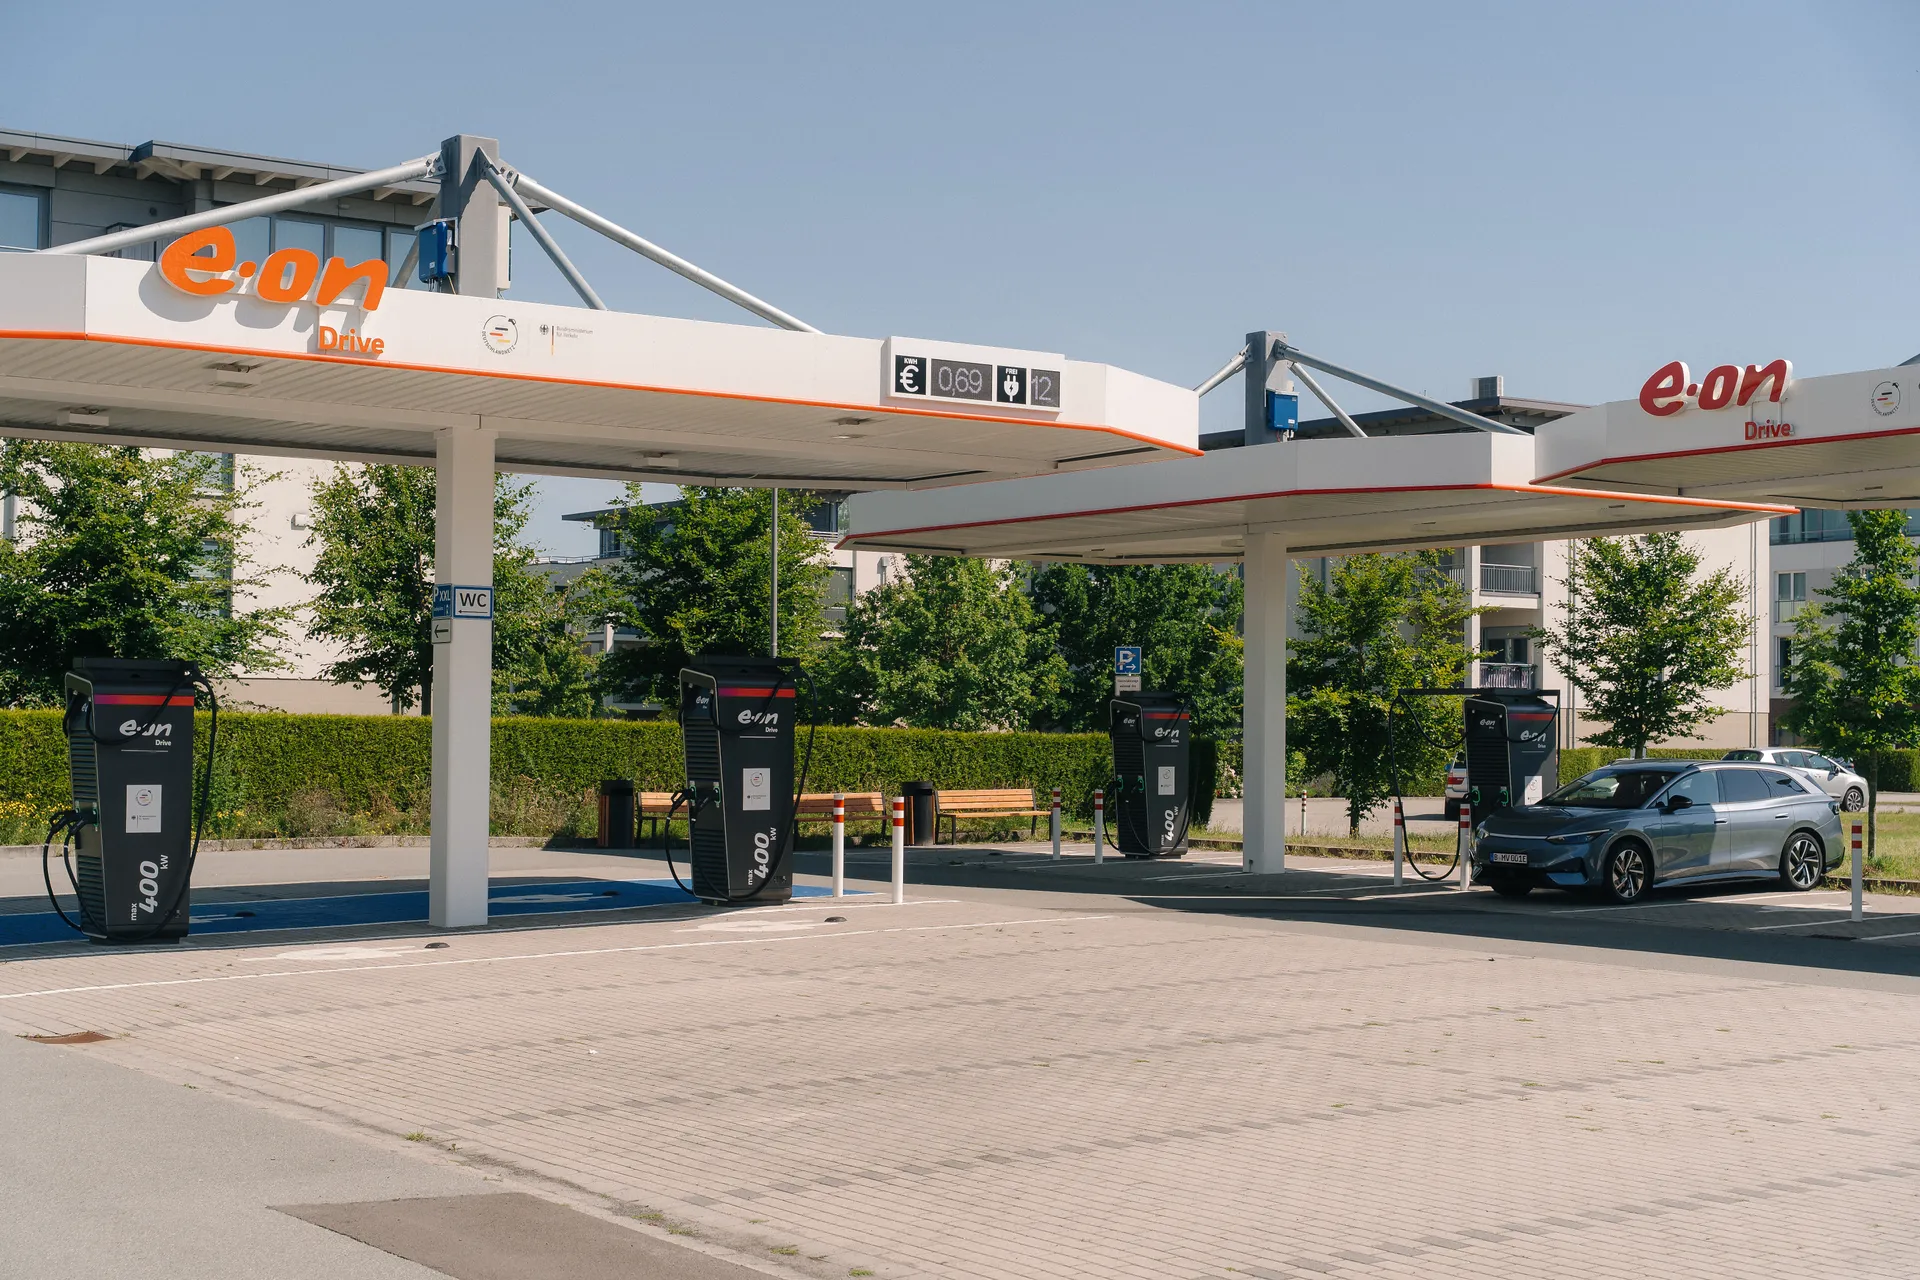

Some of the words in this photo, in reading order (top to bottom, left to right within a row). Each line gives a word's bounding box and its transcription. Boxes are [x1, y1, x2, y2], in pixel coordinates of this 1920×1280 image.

[318, 326, 385, 354] Drive
[904, 357, 918, 365] KWH
[900, 365, 919, 392] €
[938, 366, 983, 396] 0,69
[1031, 375, 1052, 401] 12
[1745, 419, 1791, 440] Drive
[439, 590, 451, 602] XXL
[459, 592, 487, 607] WC
[770, 827, 776, 840] kW
[1164, 809, 1174, 841] 400
[160, 854, 168, 870] kW
[754, 832, 769, 878] 400
[139, 861, 159, 913] 400
